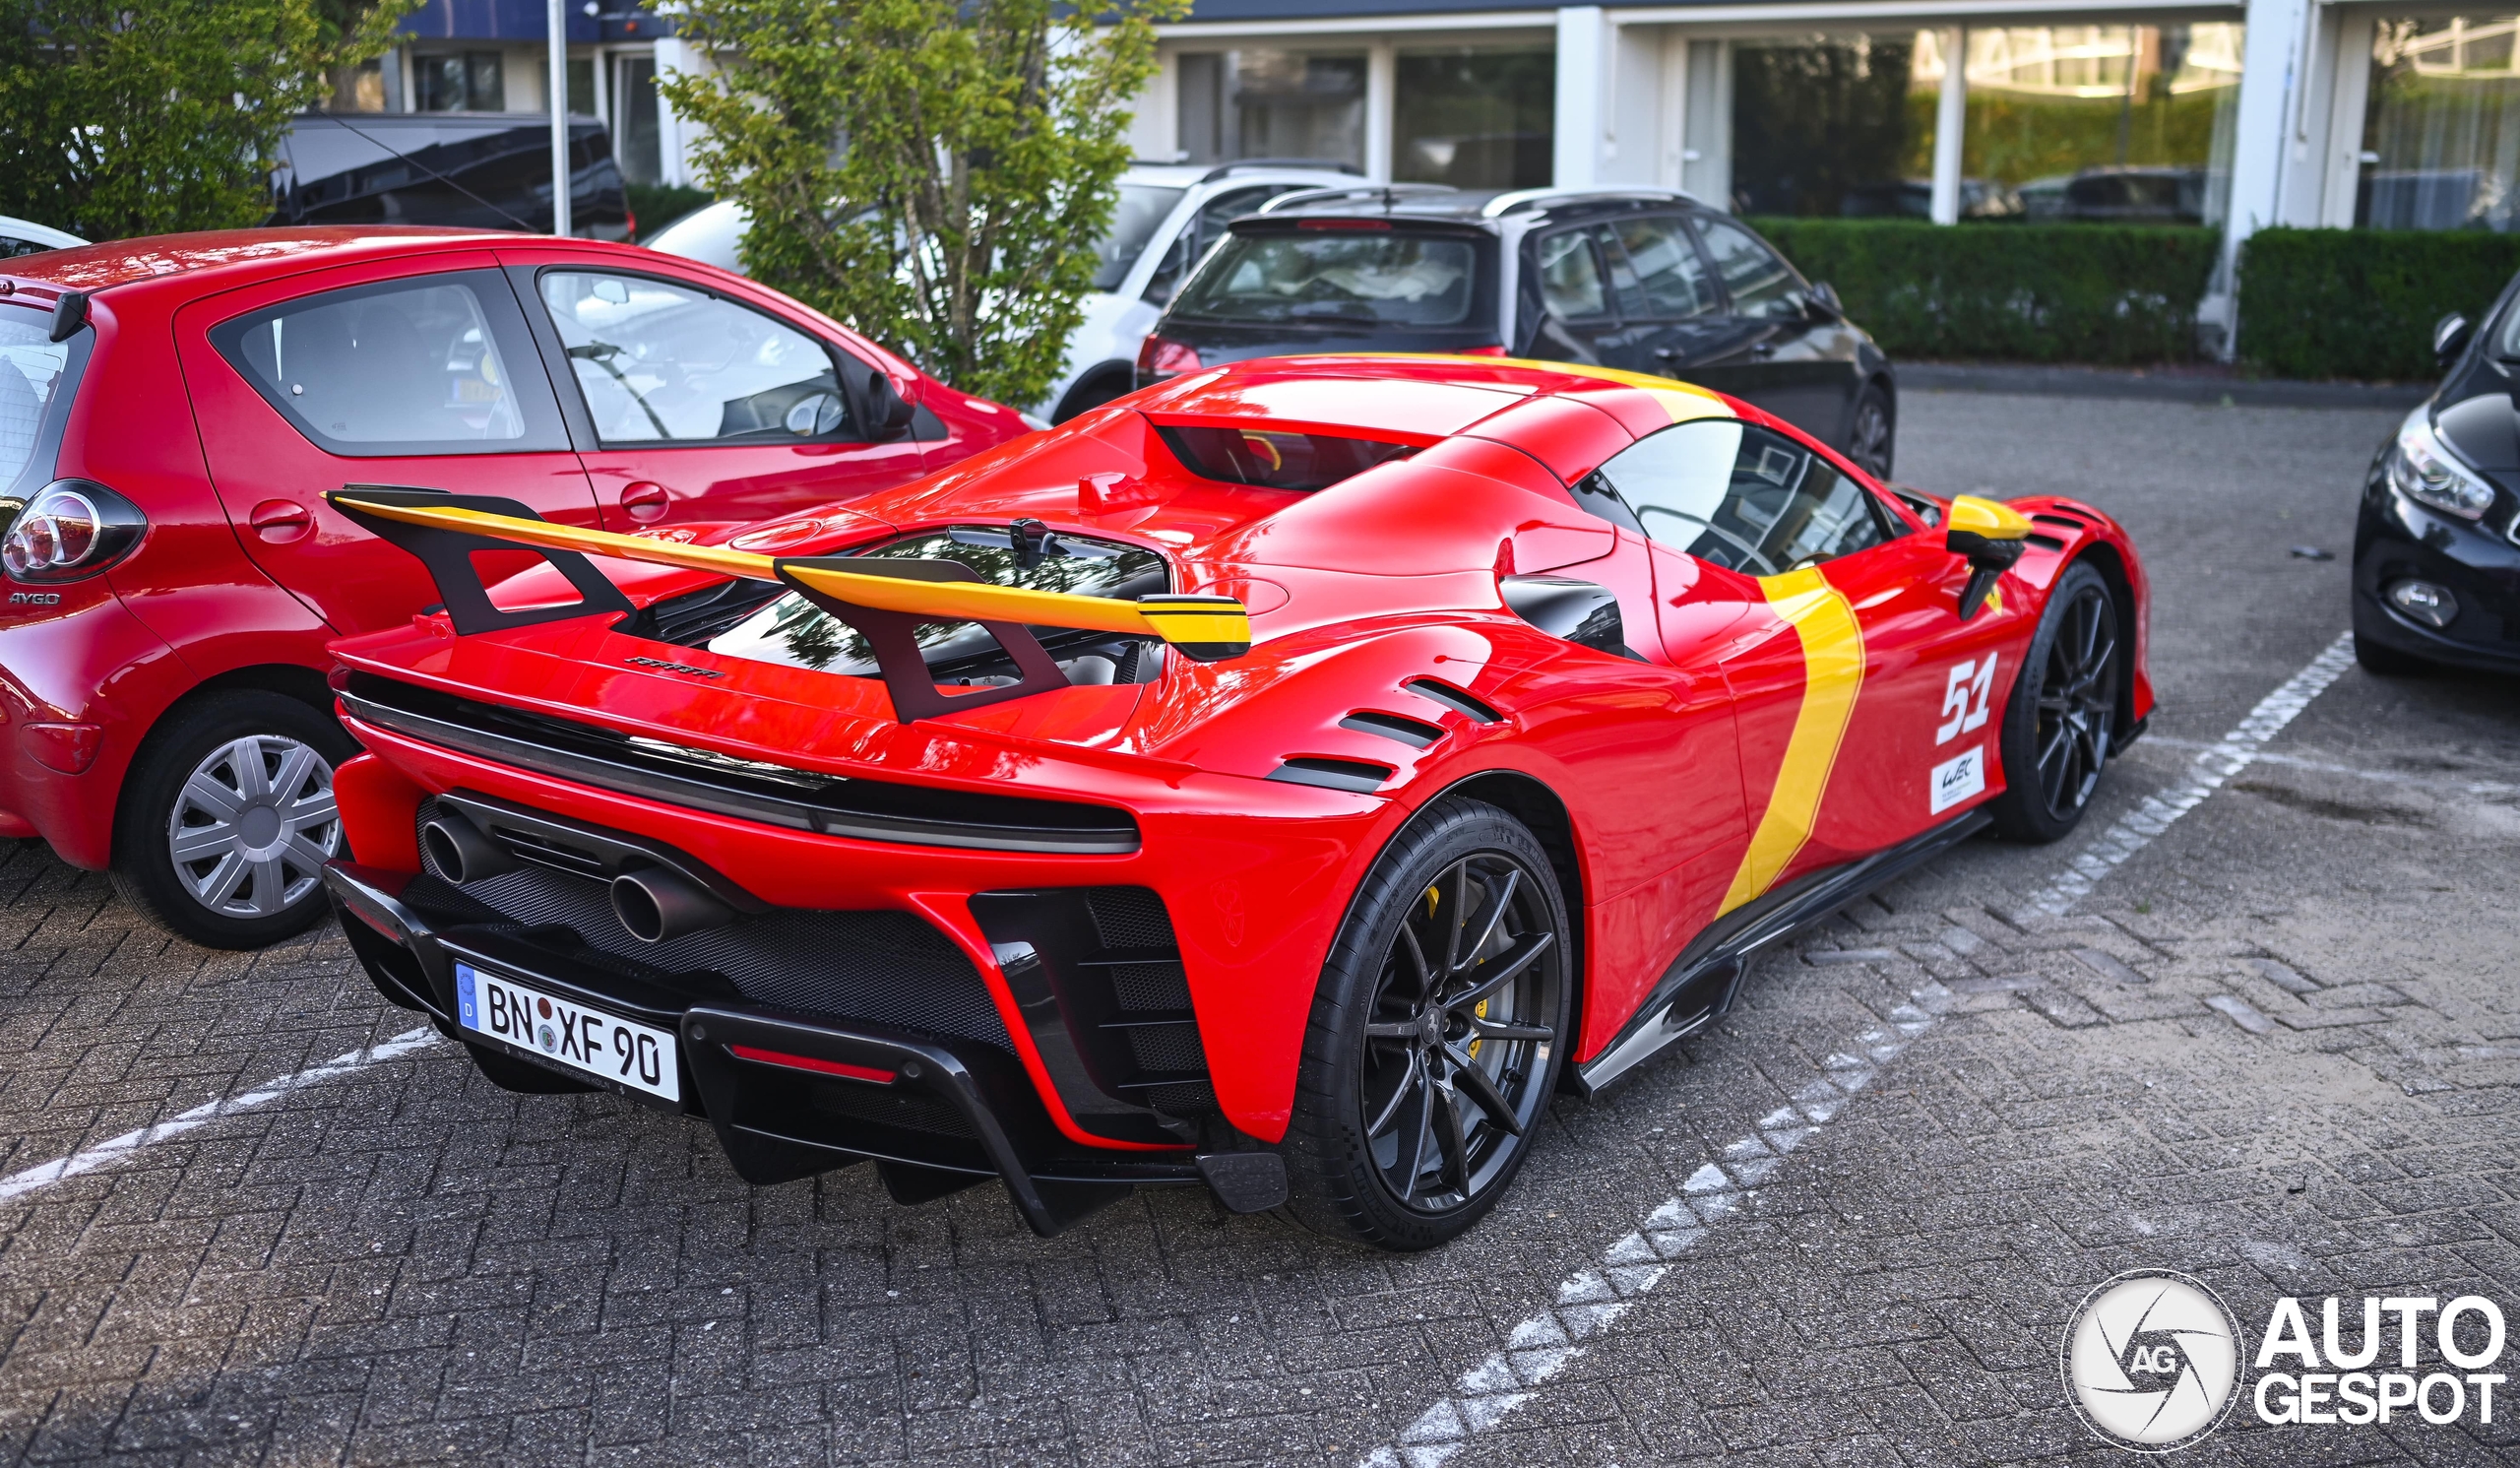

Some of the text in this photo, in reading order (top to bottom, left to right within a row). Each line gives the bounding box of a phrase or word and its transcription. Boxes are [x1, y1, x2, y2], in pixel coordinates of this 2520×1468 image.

[9, 592, 60, 605] AYGO
[624, 657, 725, 679] Ferrari
[1935, 651, 1998, 746] 51
[1942, 756, 1974, 790] WEC
[465, 1002, 472, 1017] D
[487, 983, 661, 1086] BN XF 90
[517, 1051, 559, 1071] MARANELLO
[560, 1066, 591, 1083] MOTORS
